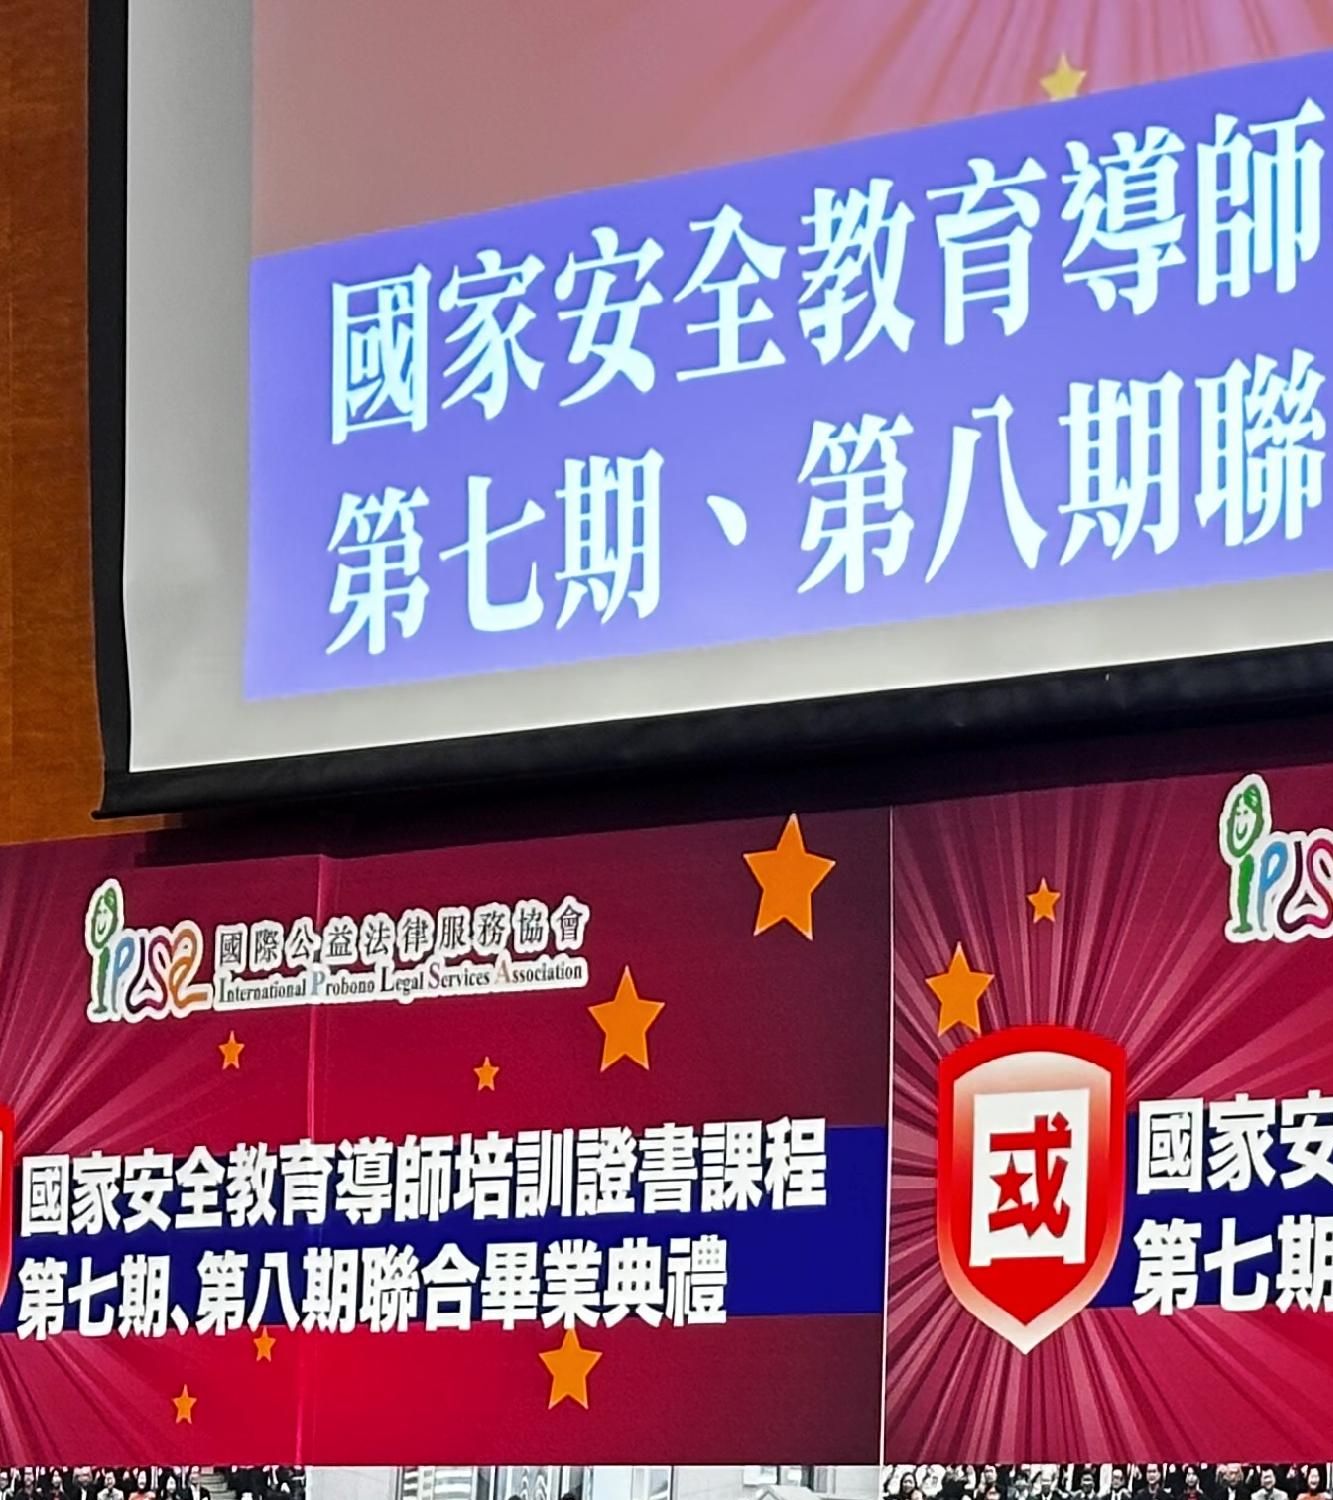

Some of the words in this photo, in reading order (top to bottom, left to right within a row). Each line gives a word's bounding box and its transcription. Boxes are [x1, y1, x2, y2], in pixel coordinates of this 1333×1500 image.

[218, 903, 585, 966] 國際公益法律服務協會
[218, 976, 306, 1004] International
[311, 970, 375, 998] Probono
[380, 965, 425, 997] Legal
[428, 961, 490, 989] Services
[494, 957, 583, 984] Association
[19, 1116, 828, 1237] 國家安全教育導師培訓證書課程
[15, 1234, 728, 1342] 第七期、第八期聯合畢業典禮
